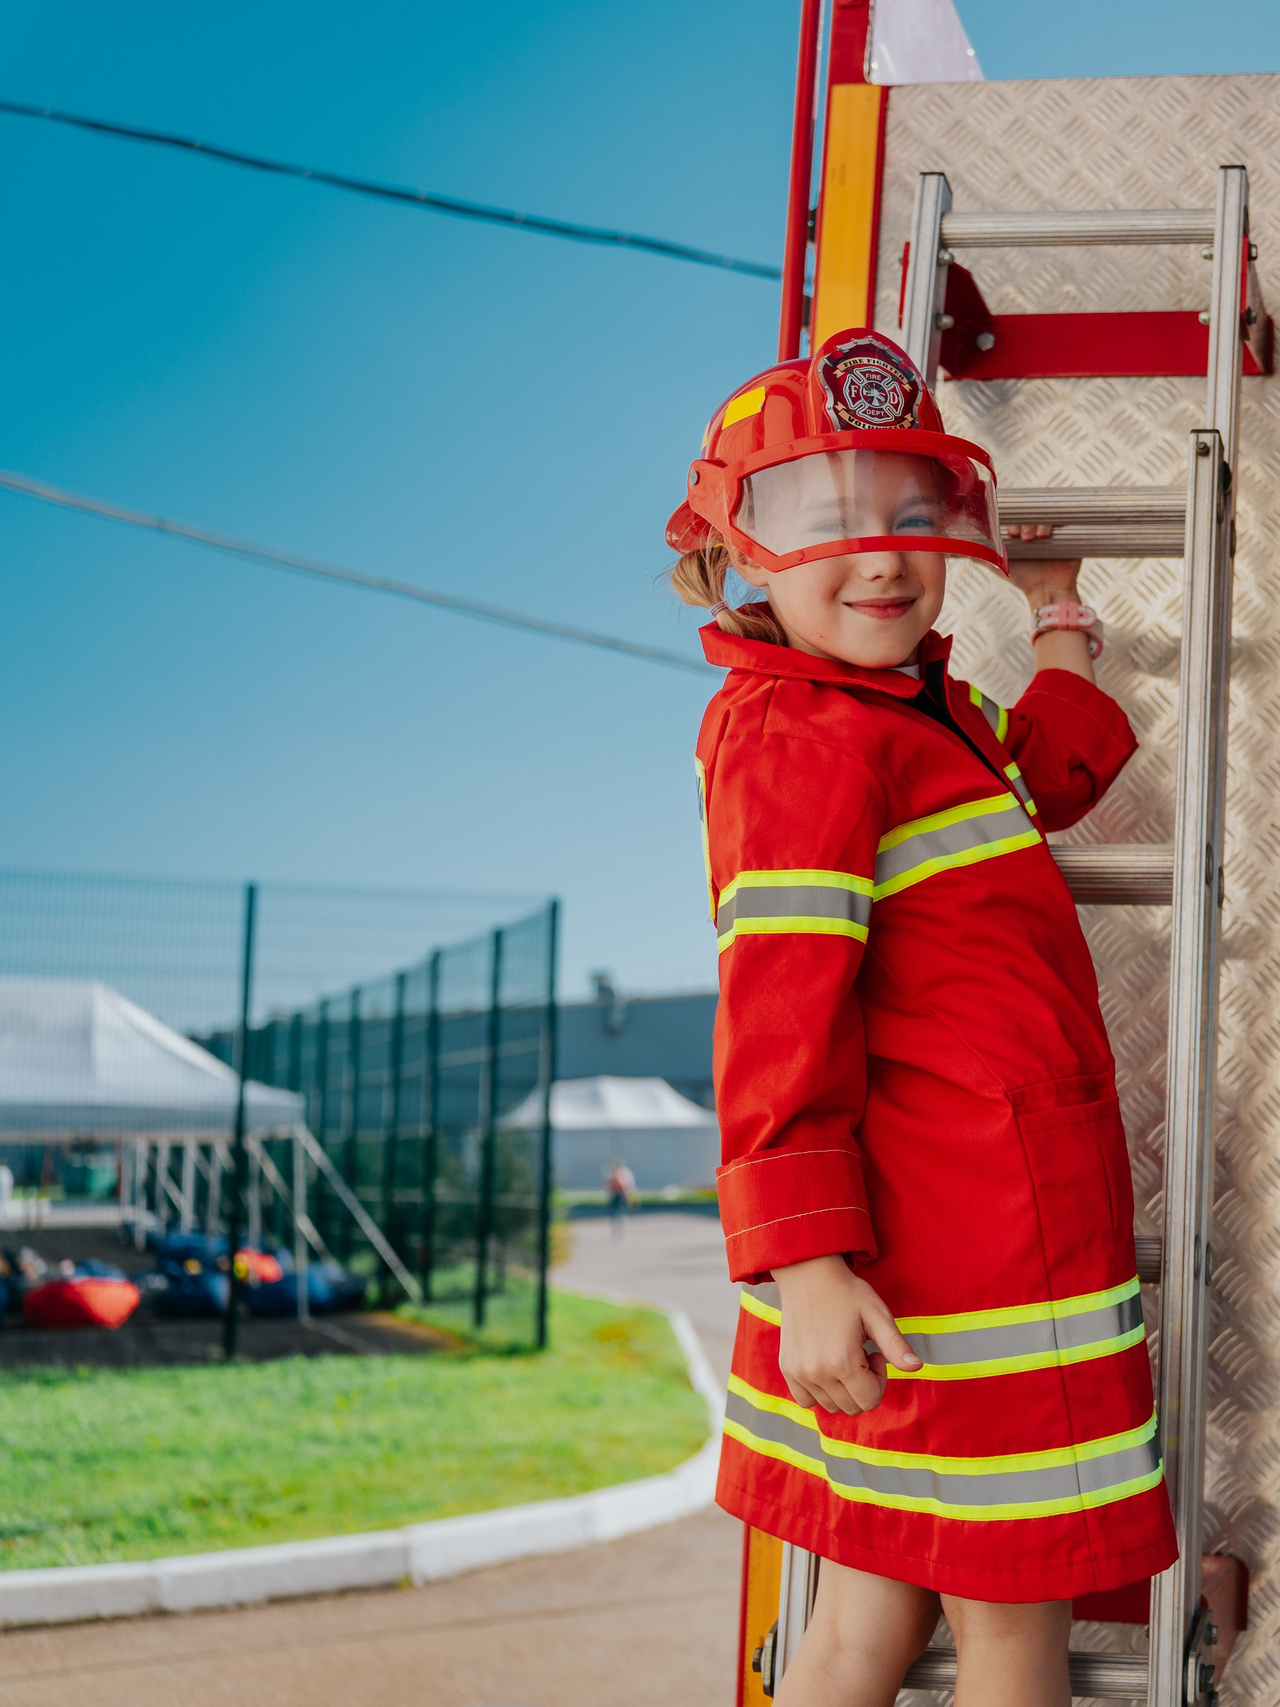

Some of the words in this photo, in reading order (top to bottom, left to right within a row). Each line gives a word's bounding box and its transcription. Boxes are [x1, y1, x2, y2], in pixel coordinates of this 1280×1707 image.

[843, 358, 864, 368] FIRE
[866, 358, 905, 380] FIGHTER
[850, 385, 858, 398] F
[889, 392, 898, 404] D
[866, 409, 886, 417] DEPT.
[847, 416, 905, 429] VOLUER
